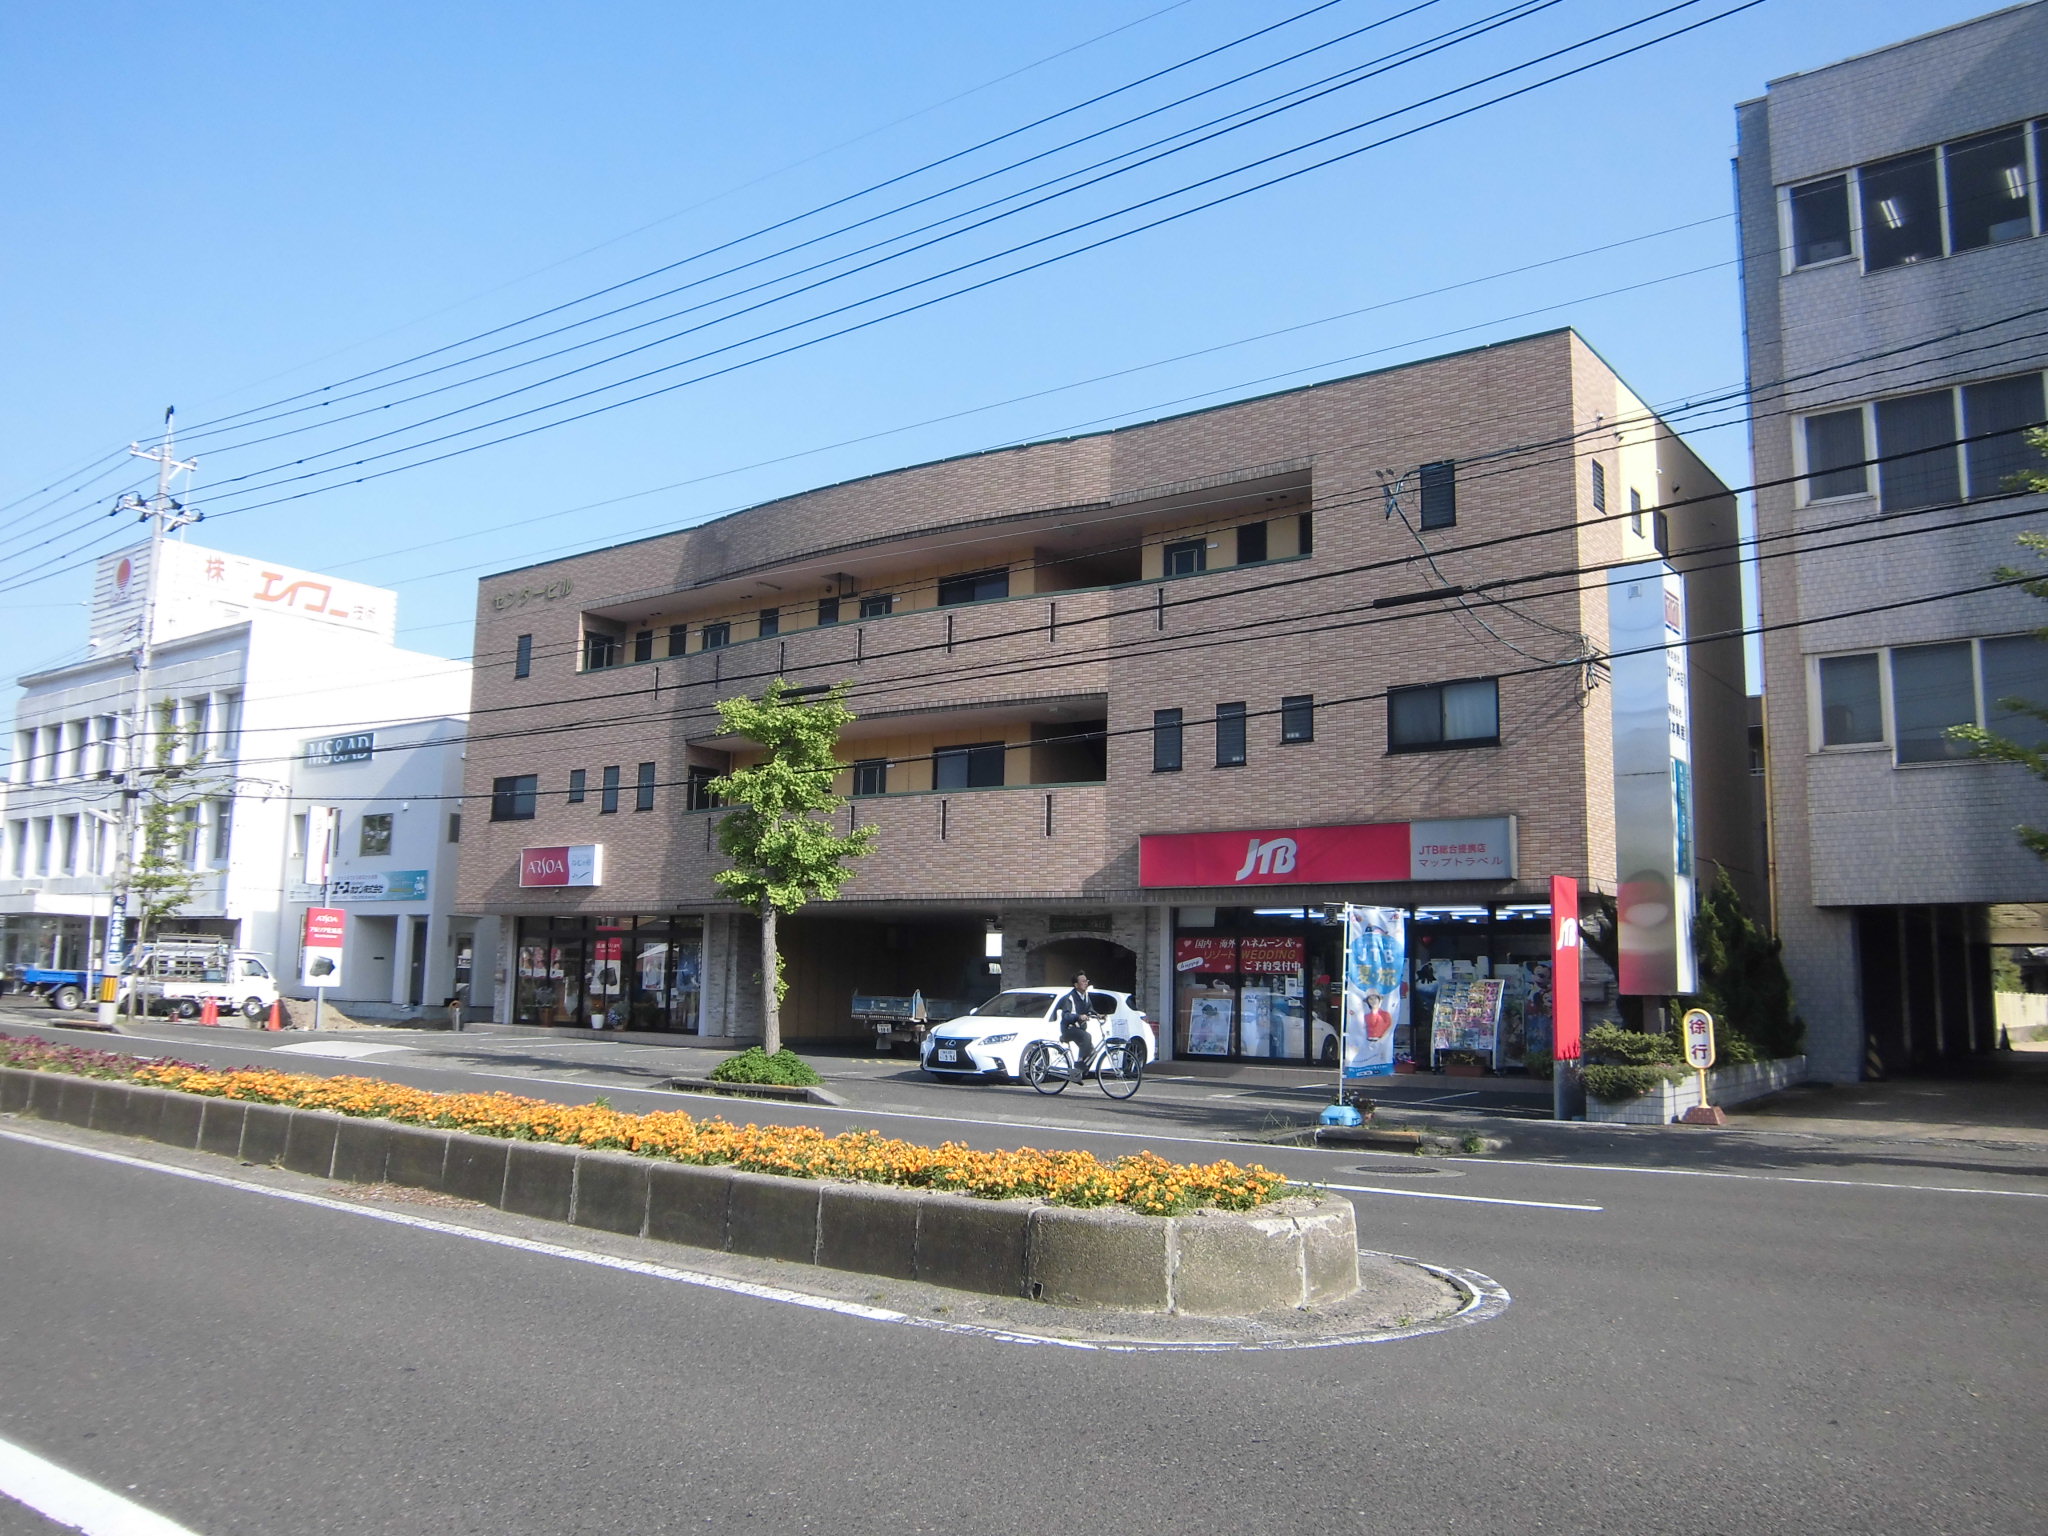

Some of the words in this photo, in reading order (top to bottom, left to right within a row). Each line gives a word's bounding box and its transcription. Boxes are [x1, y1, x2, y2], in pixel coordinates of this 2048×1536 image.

[254, 571, 350, 618] エイコー
[308, 736, 371, 766] MS&AD
[526, 857, 565, 879] ARSOA
[1235, 837, 1298, 881] JTB
[1418, 856, 1504, 868] マップトラベル
[1556, 916, 1578, 950] JTB
[1241, 949, 1296, 960] WEDDING
[1244, 960, 1301, 972] ご予約受付中
[1357, 948, 1395, 964] JTB
[1689, 1018, 1708, 1060] 徐行
